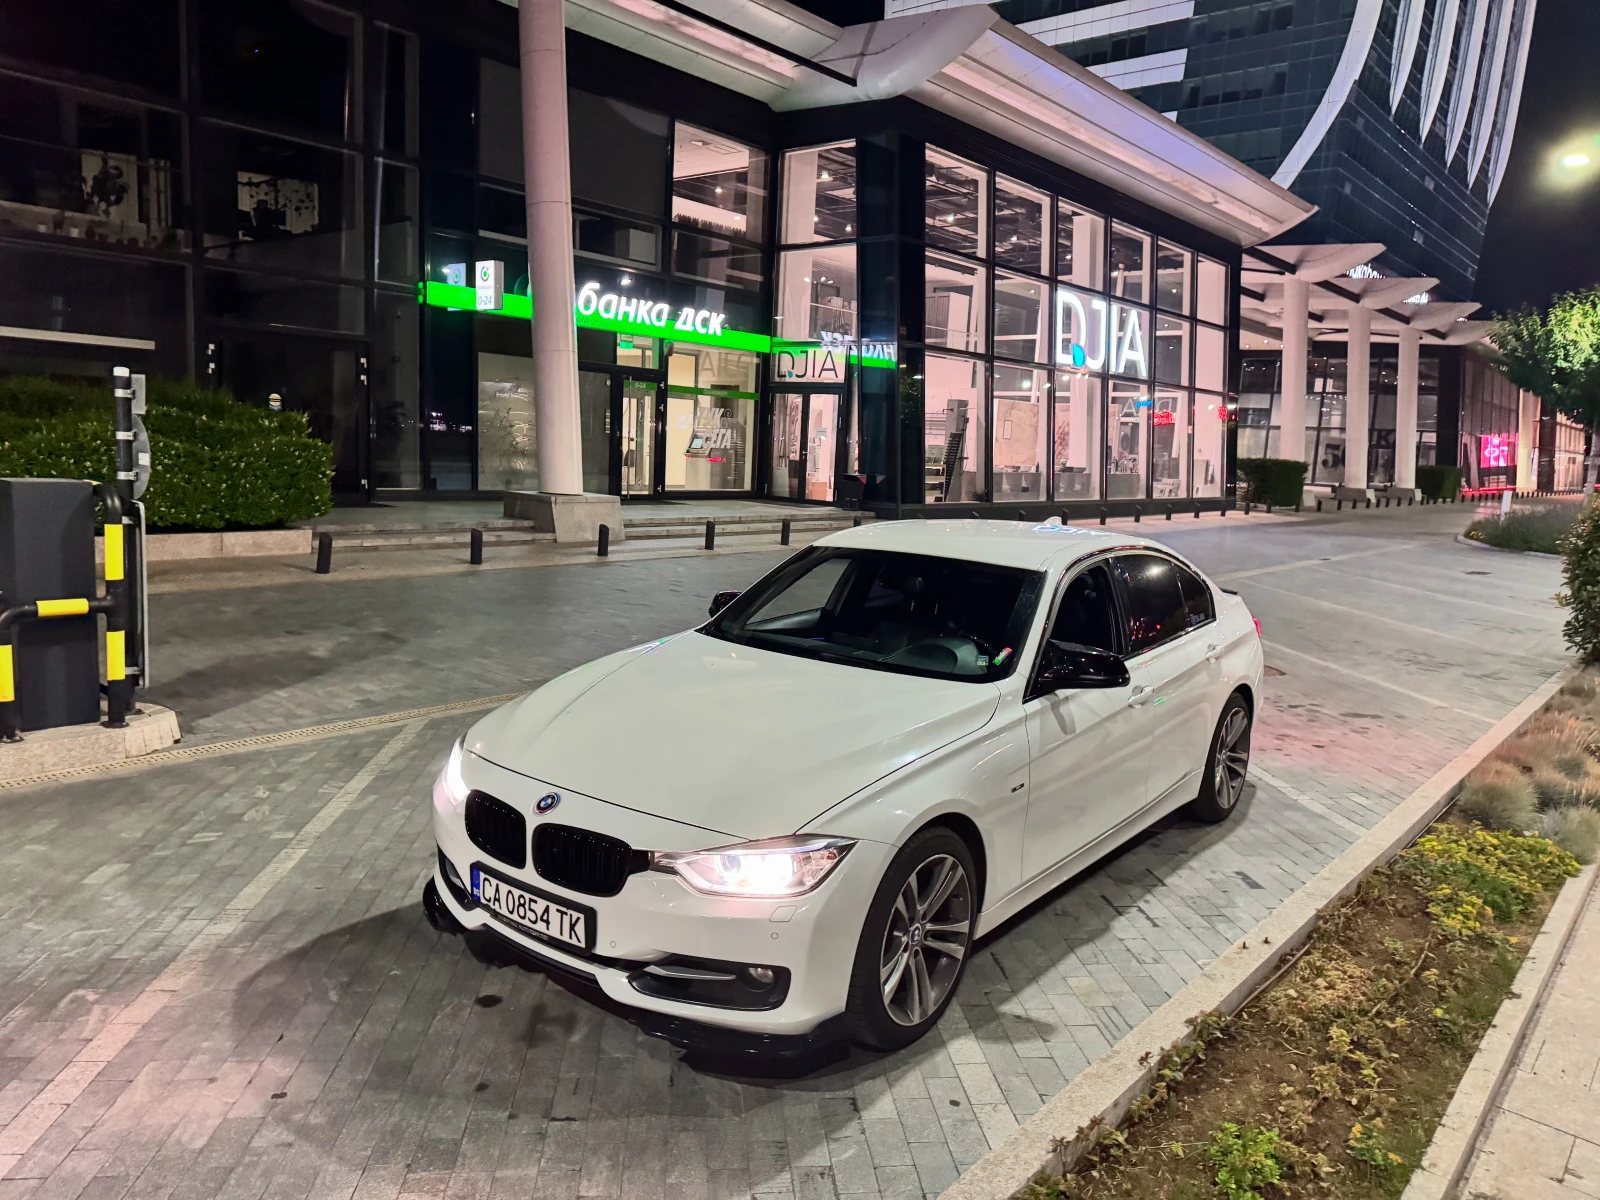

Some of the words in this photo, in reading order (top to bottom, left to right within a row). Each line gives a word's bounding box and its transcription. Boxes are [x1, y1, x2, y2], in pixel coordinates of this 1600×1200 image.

[477, 295, 493, 306] 0-24
[577, 282, 670, 328] банка
[1056, 288, 1148, 378] DJIA
[776, 350, 839, 379] DJIA
[482, 877, 502, 910] CA
[505, 889, 551, 931] 0854
[555, 908, 582, 944] TK
